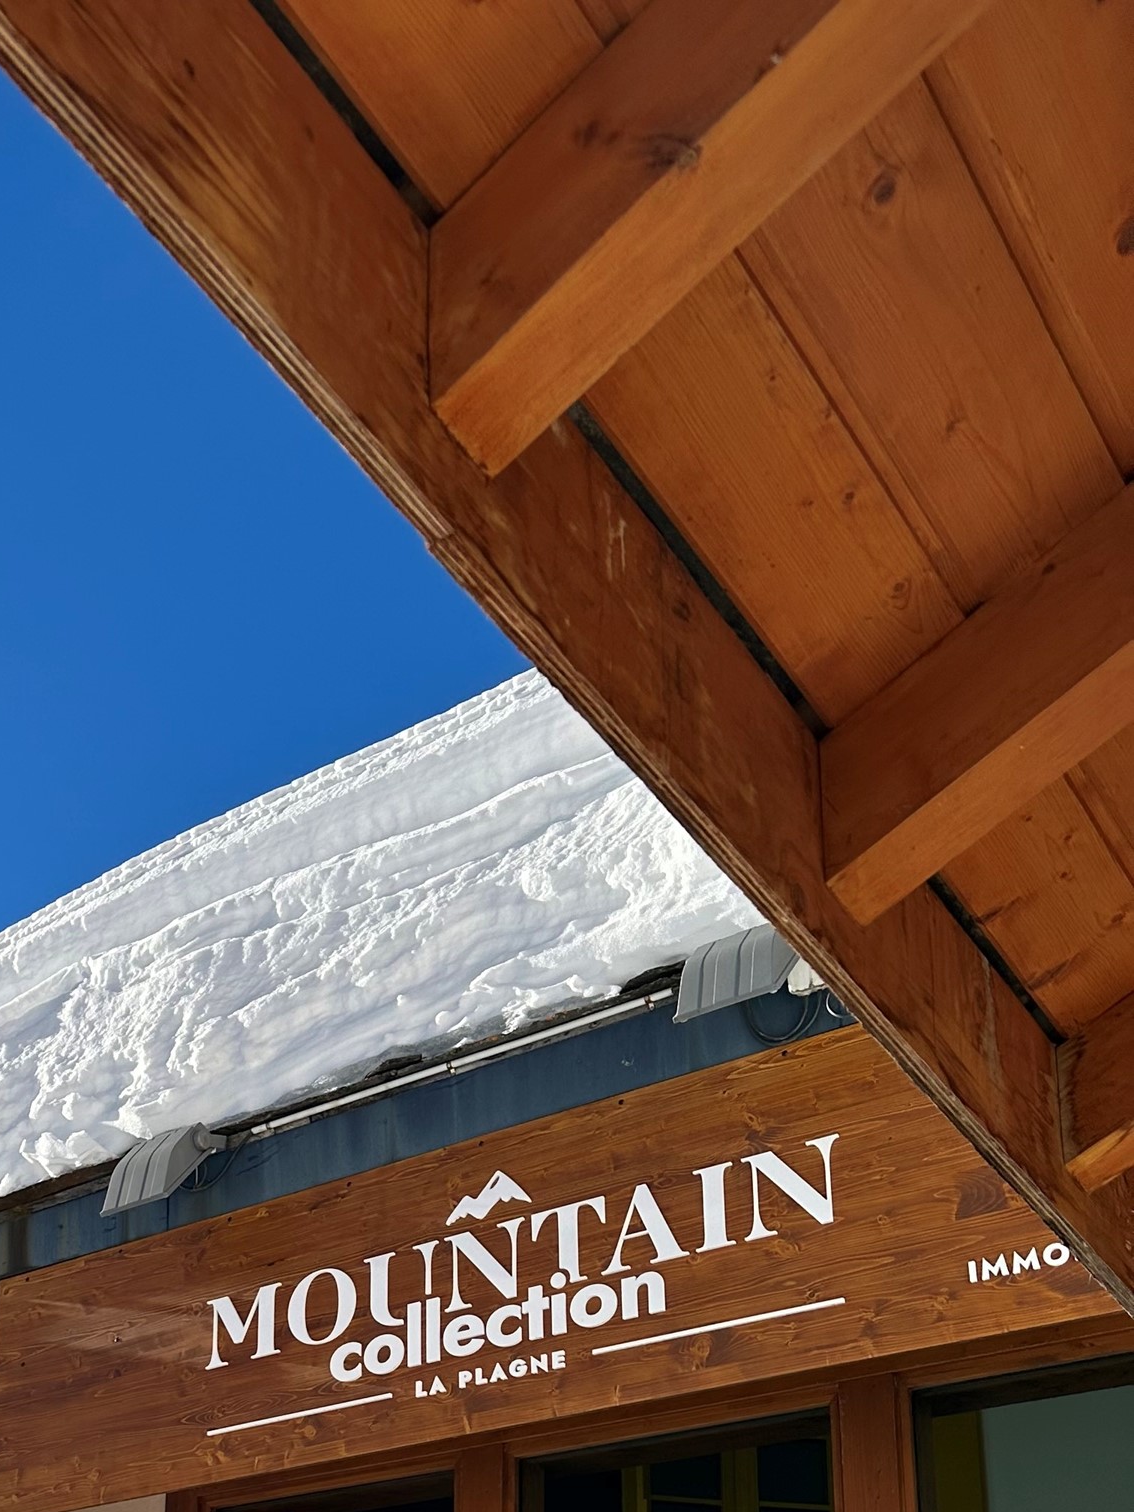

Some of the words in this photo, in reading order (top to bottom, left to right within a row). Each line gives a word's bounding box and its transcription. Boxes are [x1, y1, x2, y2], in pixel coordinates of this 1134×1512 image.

[204, 1132, 840, 1371] MOUNTAIN
[967, 1241, 1079, 1284] IMMO
[329, 1270, 667, 1383] collection
[415, 1375, 448, 1399] LA
[458, 1349, 567, 1389] PLAGNE
